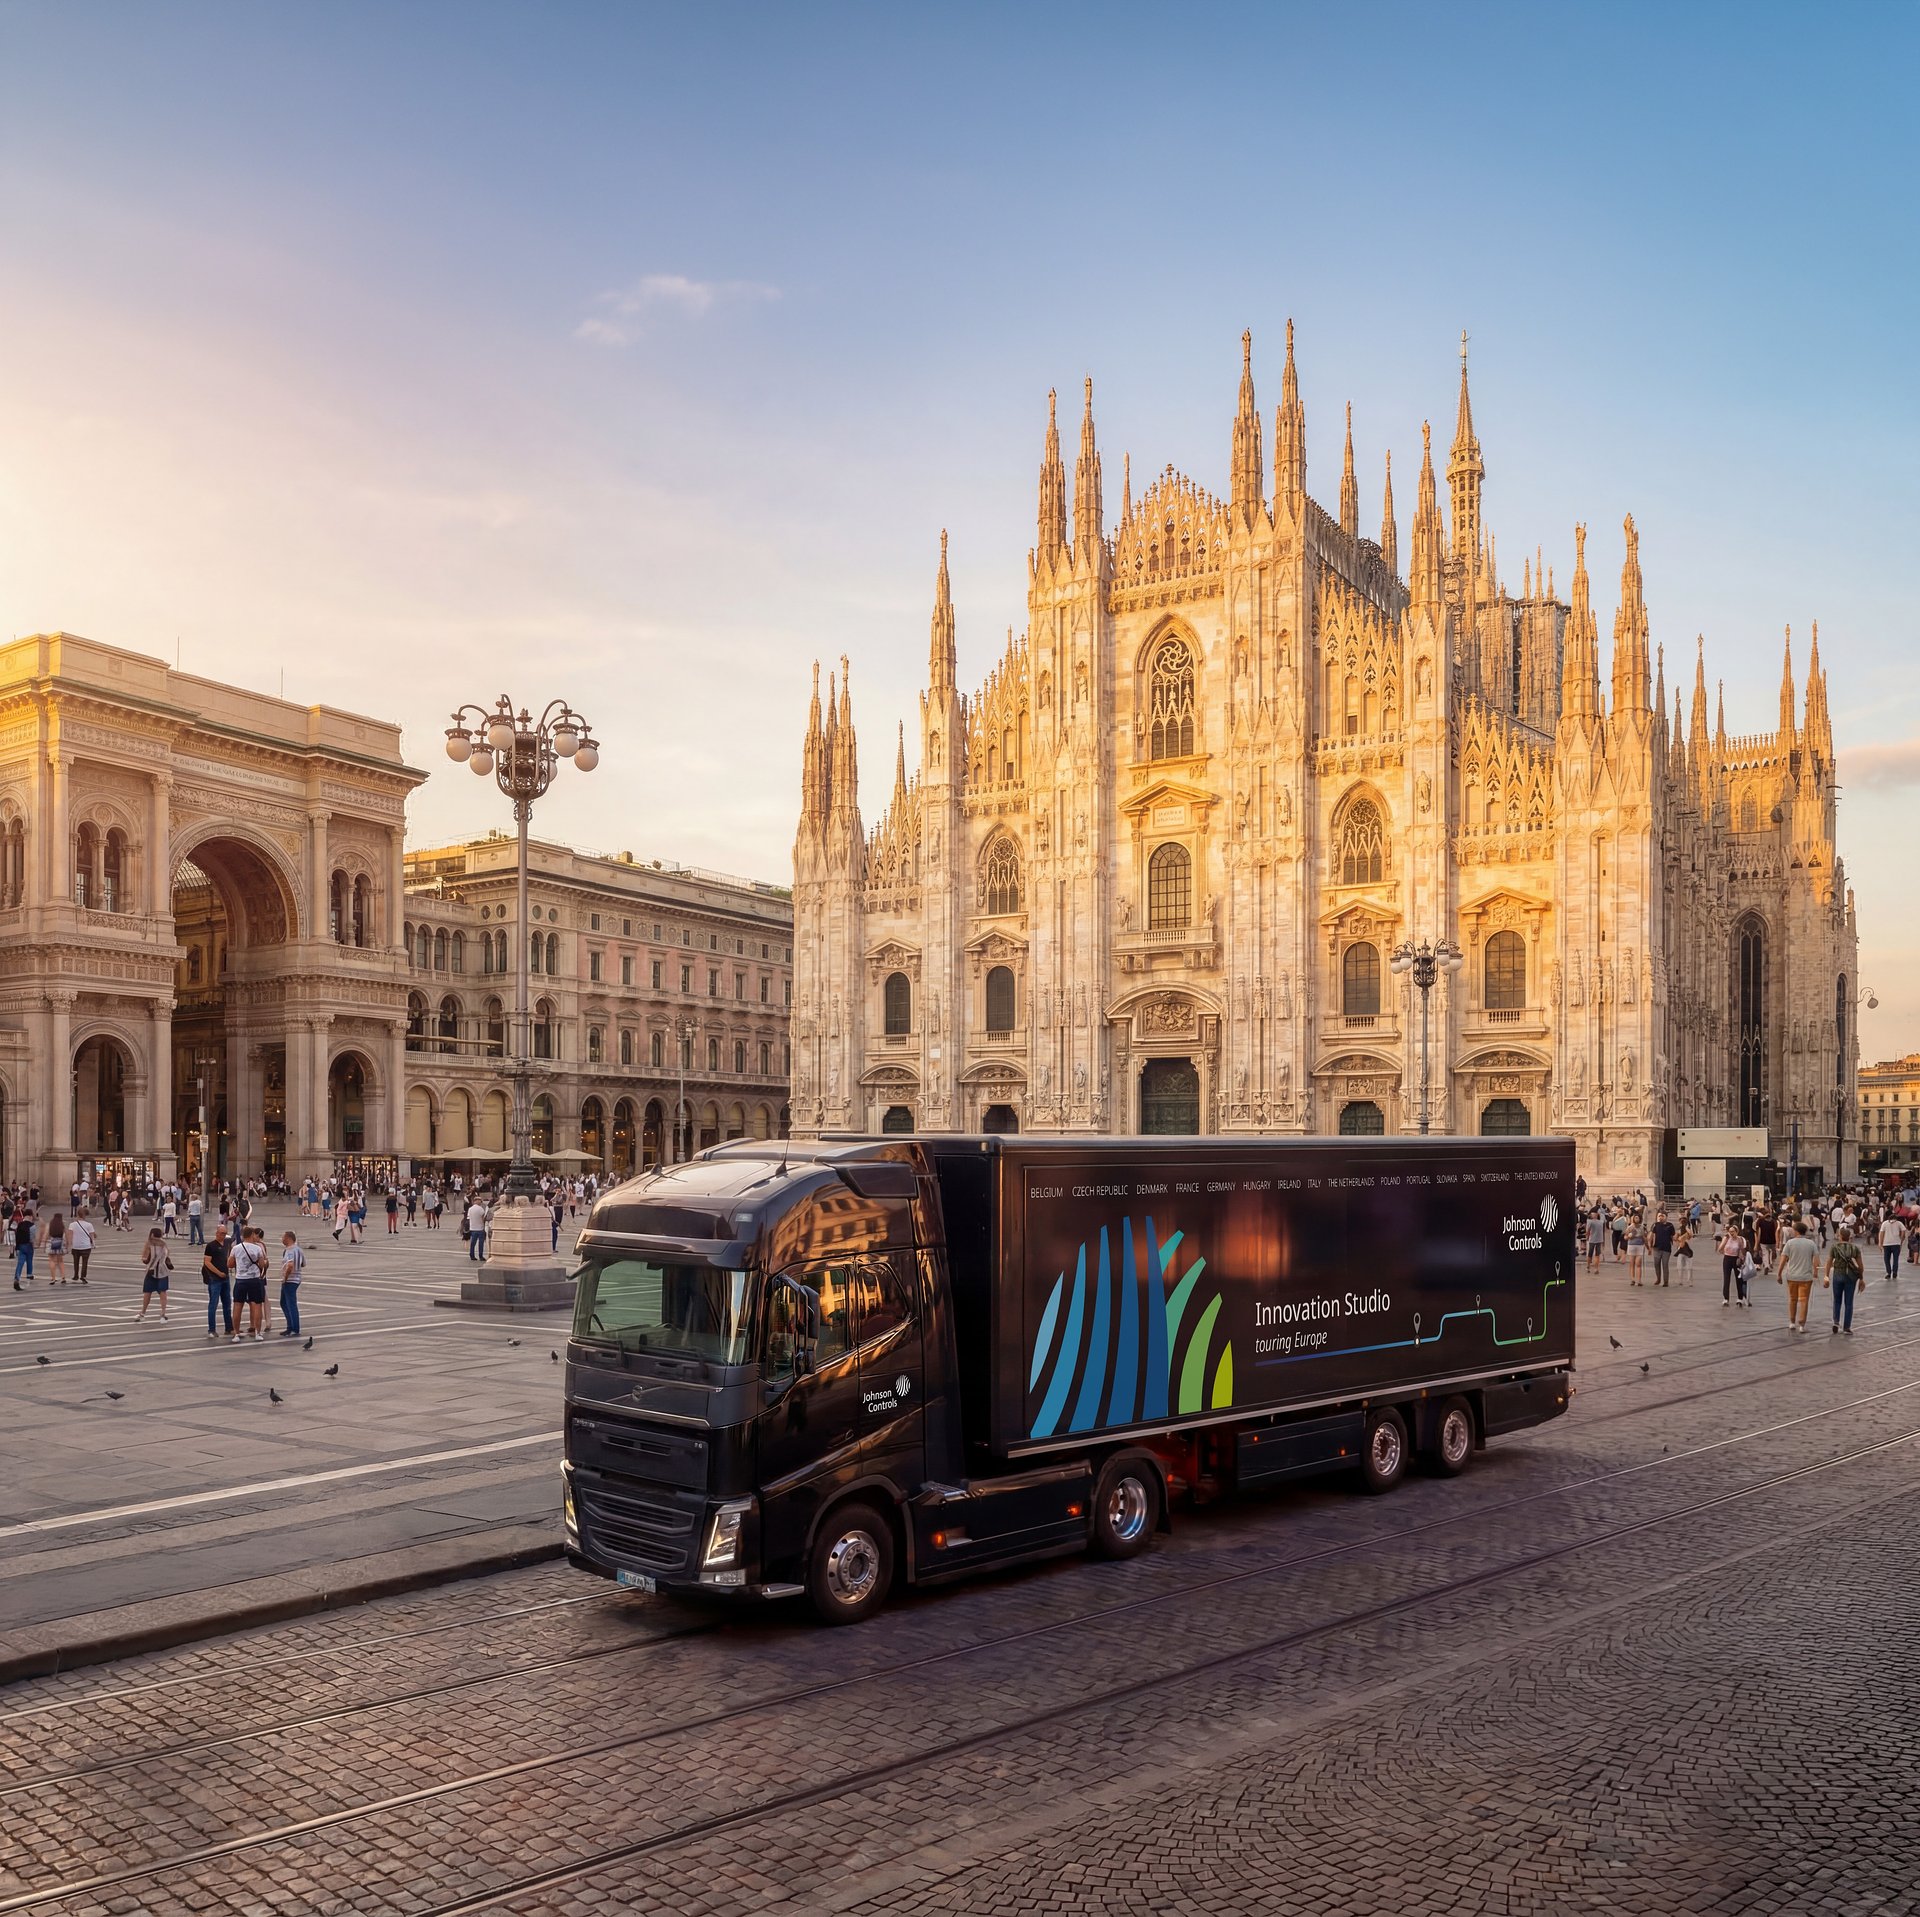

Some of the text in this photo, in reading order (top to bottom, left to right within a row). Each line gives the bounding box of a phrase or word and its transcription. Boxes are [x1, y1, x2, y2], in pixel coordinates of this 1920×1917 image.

[1030, 1171, 1559, 1198] BELGIUM CZECH REPUBLIC DENMARK FRANCE GERMANY HUNGARY IRELAND ITALY THE NETHERLANDS POLAND PORTUGAL SLOVAKIA SPAIN SWITZERLAND THE UNITED KINGDOM
[1502, 1214, 1536, 1234] Johnson
[1508, 1232, 1542, 1251] Controls
[1255, 1288, 1391, 1326] Innovation Studio
[1255, 1331, 1328, 1354] touring Europe
[862, 1390, 892, 1404] Johnson
[868, 1397, 898, 1413] Controls
